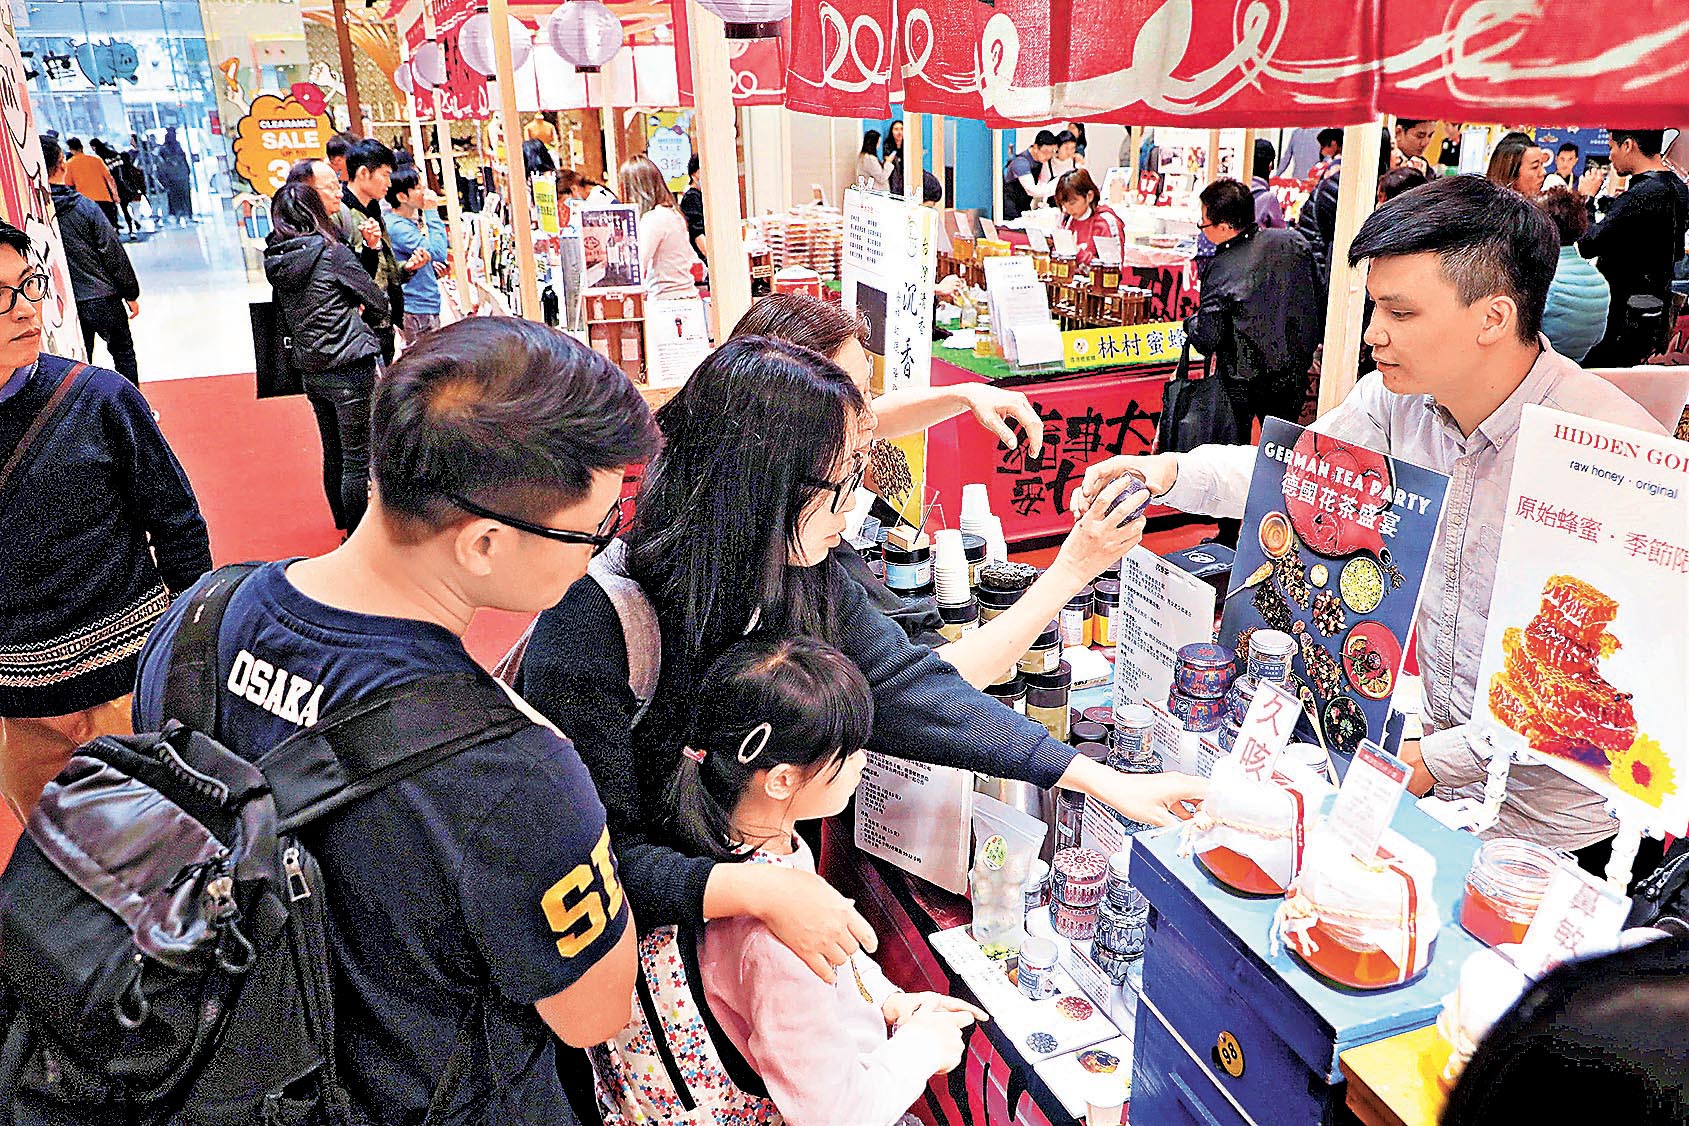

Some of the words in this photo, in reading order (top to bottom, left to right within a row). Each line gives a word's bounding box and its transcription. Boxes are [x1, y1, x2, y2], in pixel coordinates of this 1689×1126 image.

[261, 131, 320, 150] SALE
[1097, 328, 1188, 359] 林村蜜蜂
[1553, 423, 1641, 459] HIDDEN
[1264, 441, 1331, 479] GERMAN
[1331, 465, 1365, 493] TEA
[1370, 480, 1432, 516] PARTY
[1569, 460, 1590, 473] raw
[1591, 465, 1625, 486] honey
[1635, 479, 1679, 500] original
[1281, 471, 1401, 539] 德國花茶盛宴
[1515, 495, 1602, 544] 原始蜂蜜
[227, 648, 325, 728] OSAKA
[1239, 692, 1284, 783] 久咳
[1221, 1041, 1238, 1065] 98
